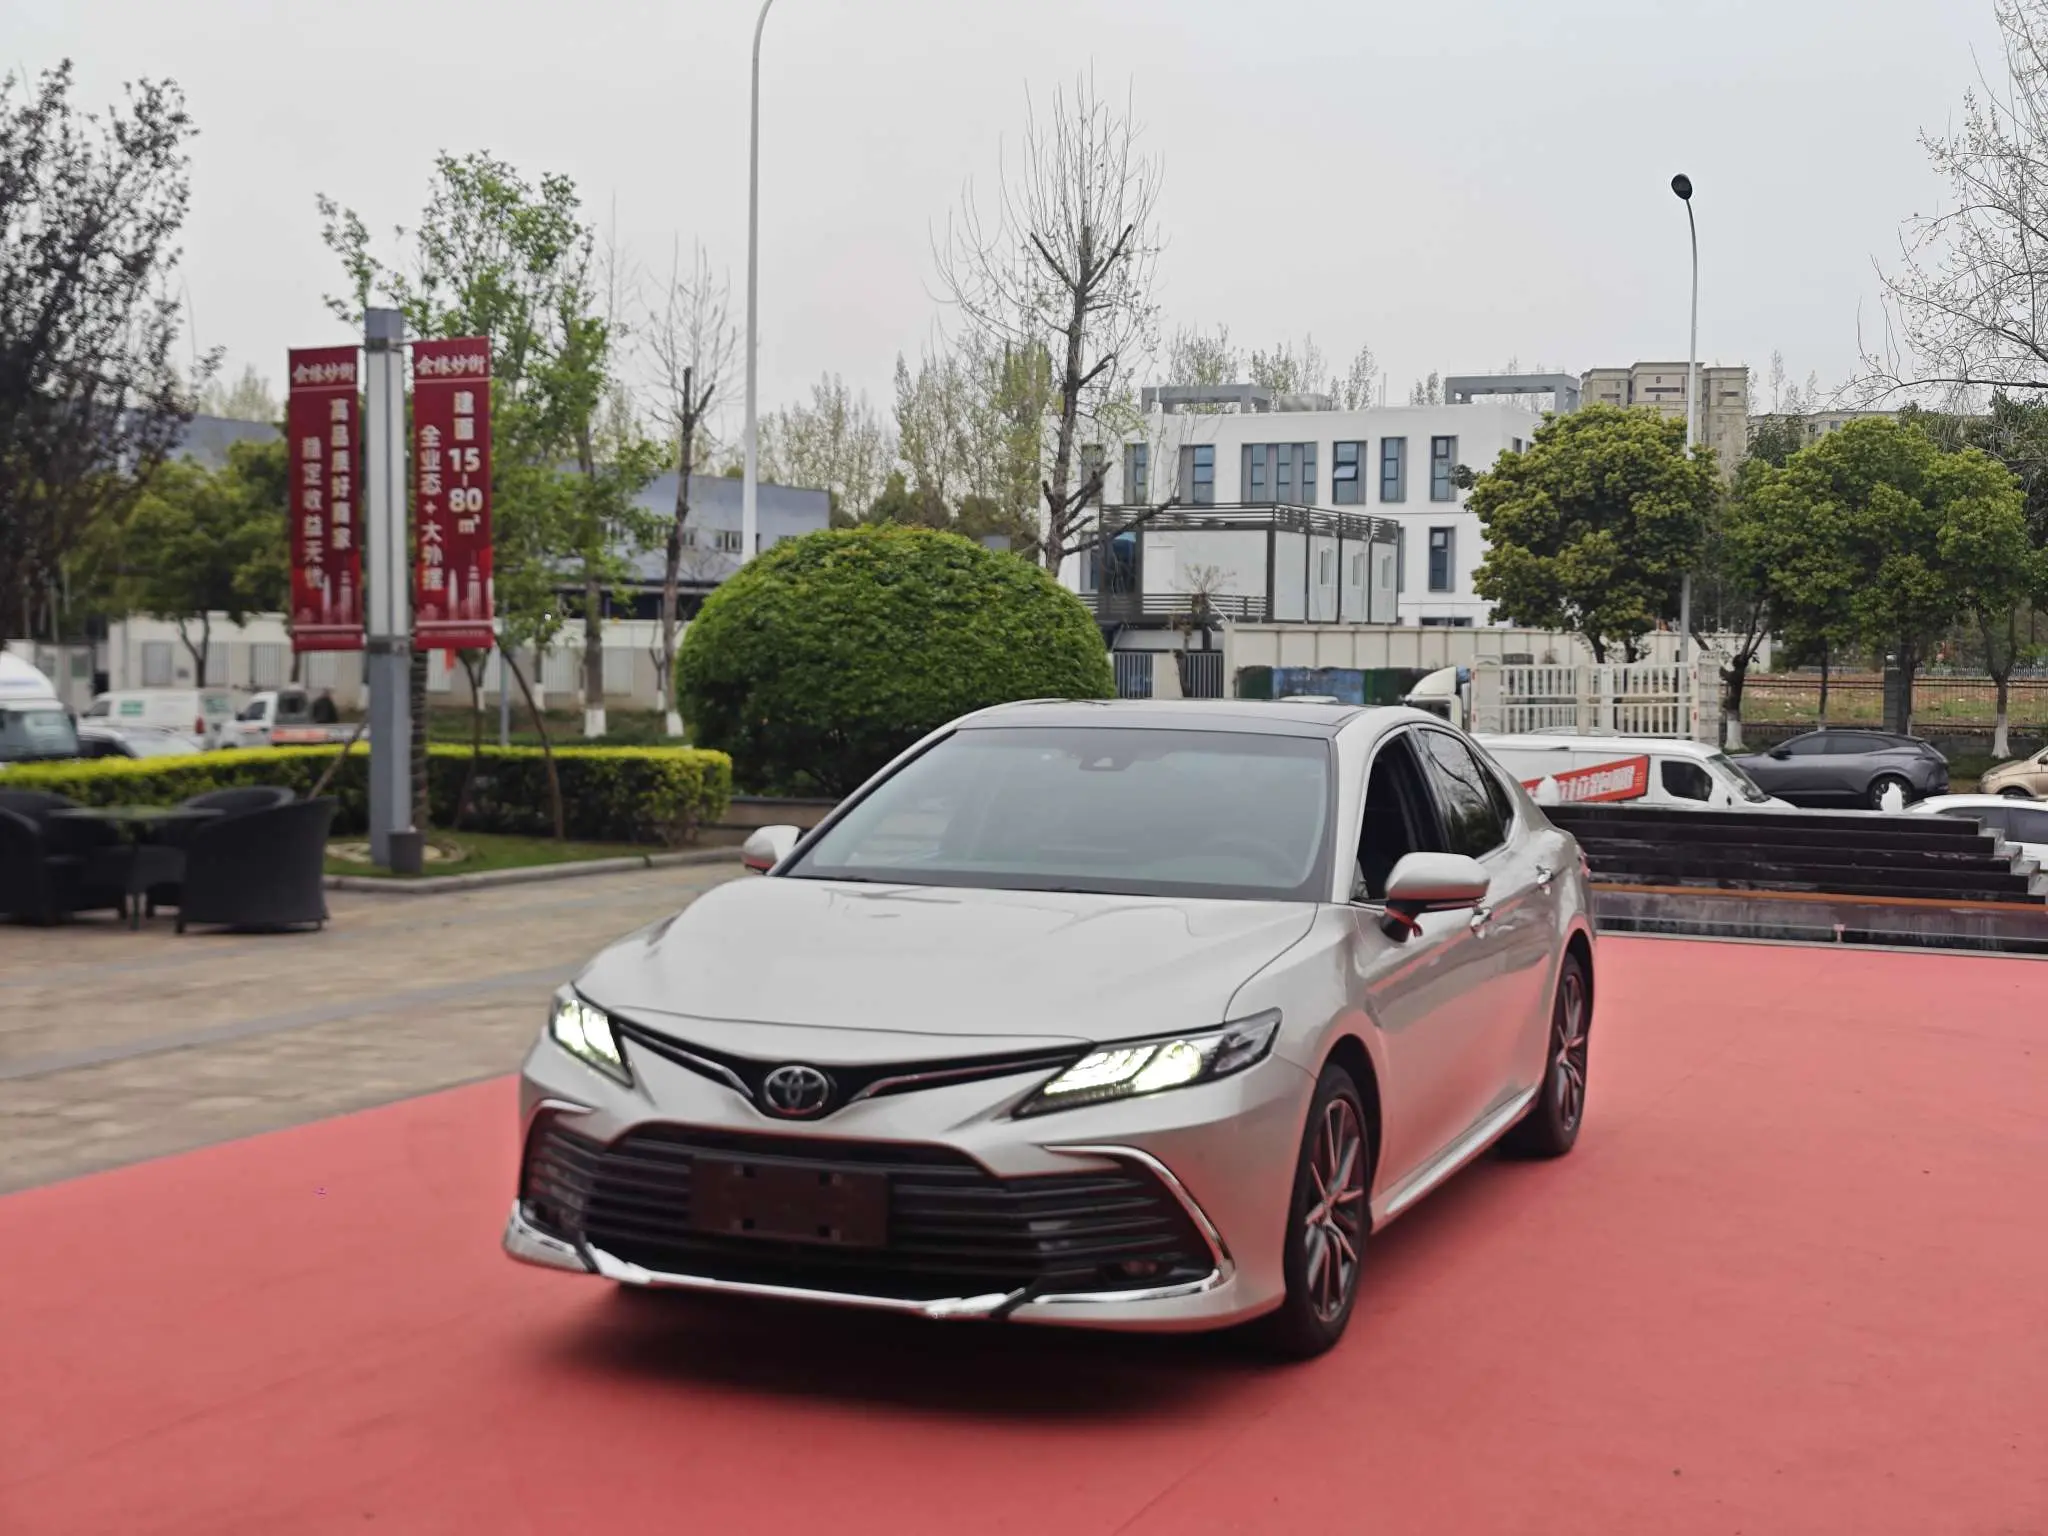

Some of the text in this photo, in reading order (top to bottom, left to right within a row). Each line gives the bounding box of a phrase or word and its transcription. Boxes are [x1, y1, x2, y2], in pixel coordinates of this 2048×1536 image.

[453, 390, 475, 440] 建面
[448, 447, 481, 473] 15
[449, 487, 484, 514] 80
